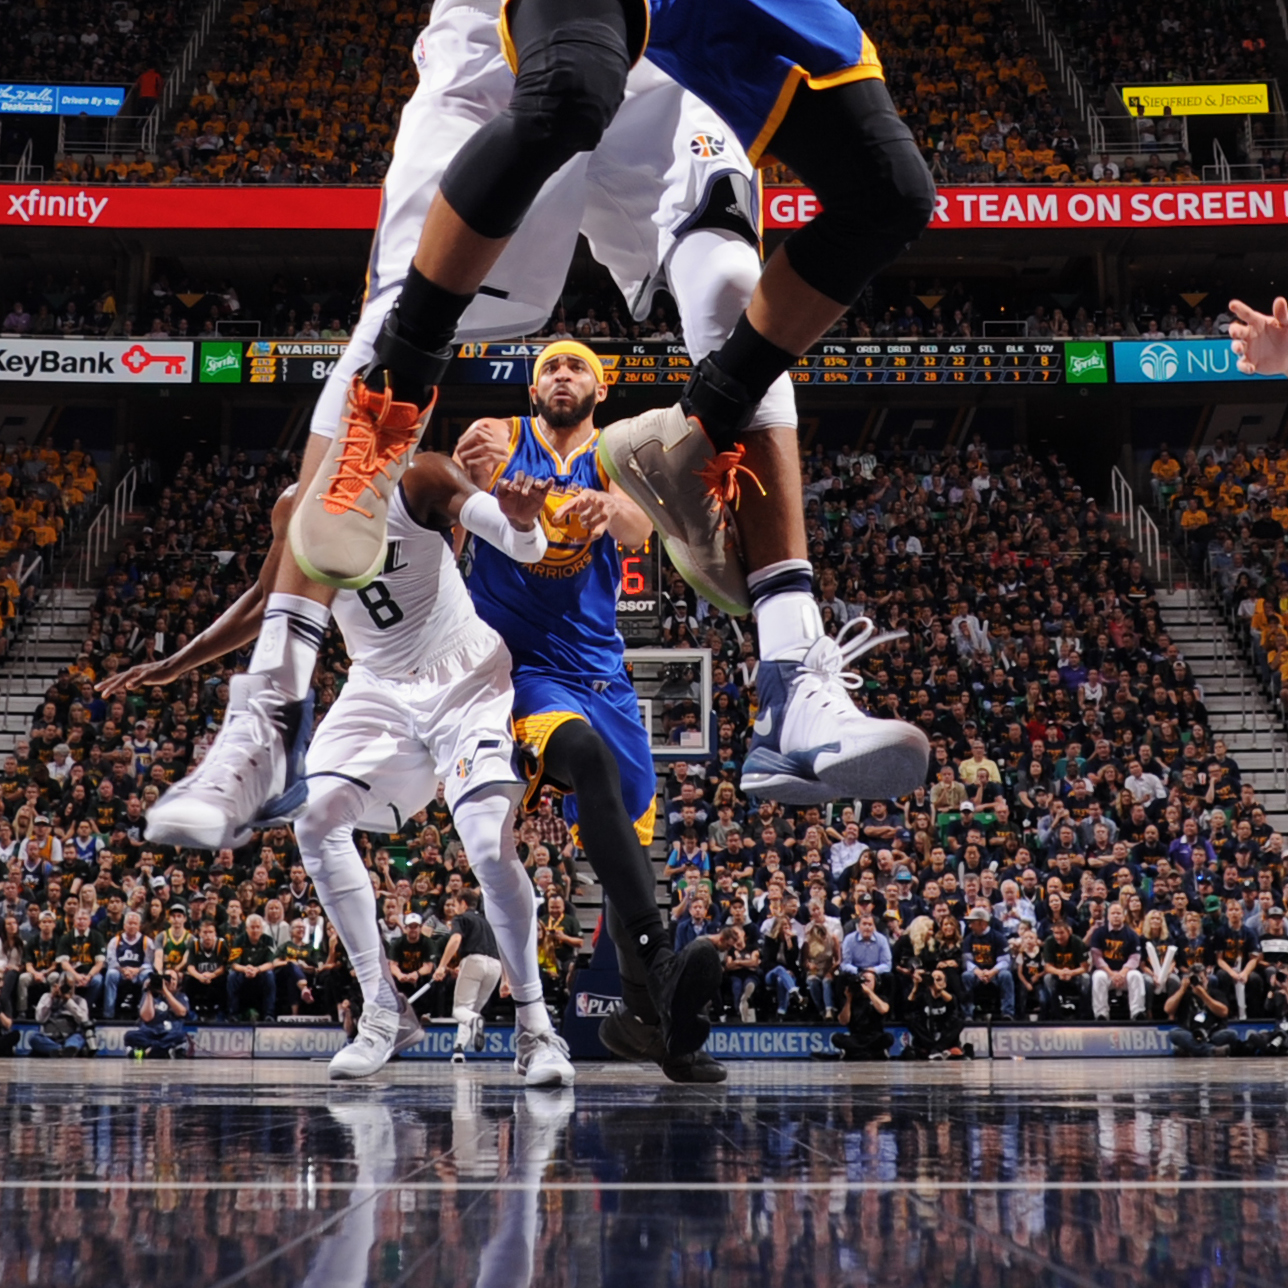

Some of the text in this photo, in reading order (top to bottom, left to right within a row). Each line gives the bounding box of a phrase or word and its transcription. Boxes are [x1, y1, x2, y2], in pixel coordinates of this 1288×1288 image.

[61, 96, 90, 106] Driven
[91, 96, 103, 107] By
[1143, 93, 1264, 108] SIEGFRIED & JENSEN
[7, 188, 109, 224] xfinity
[770, 194, 817, 224] GE
[957, 195, 1058, 223] TEAM
[1067, 193, 1121, 223] ON
[1131, 190, 1274, 222] SCREEN
[632, 344, 1054, 354] FG AST STL TOV
[204, 351, 240, 373] Sprite
[489, 361, 514, 380] 77
[823, 356, 966, 367] 93% 32 22
[1070, 355, 1106, 372] Sprite
[1187, 350, 1230, 375] NU
[823, 371, 965, 382] 85% 12
[520, 554, 592, 580] ARRIORS
[621, 556, 645, 595] 6
[356, 580, 405, 630] 8
[615, 600, 656, 612] SSOT
